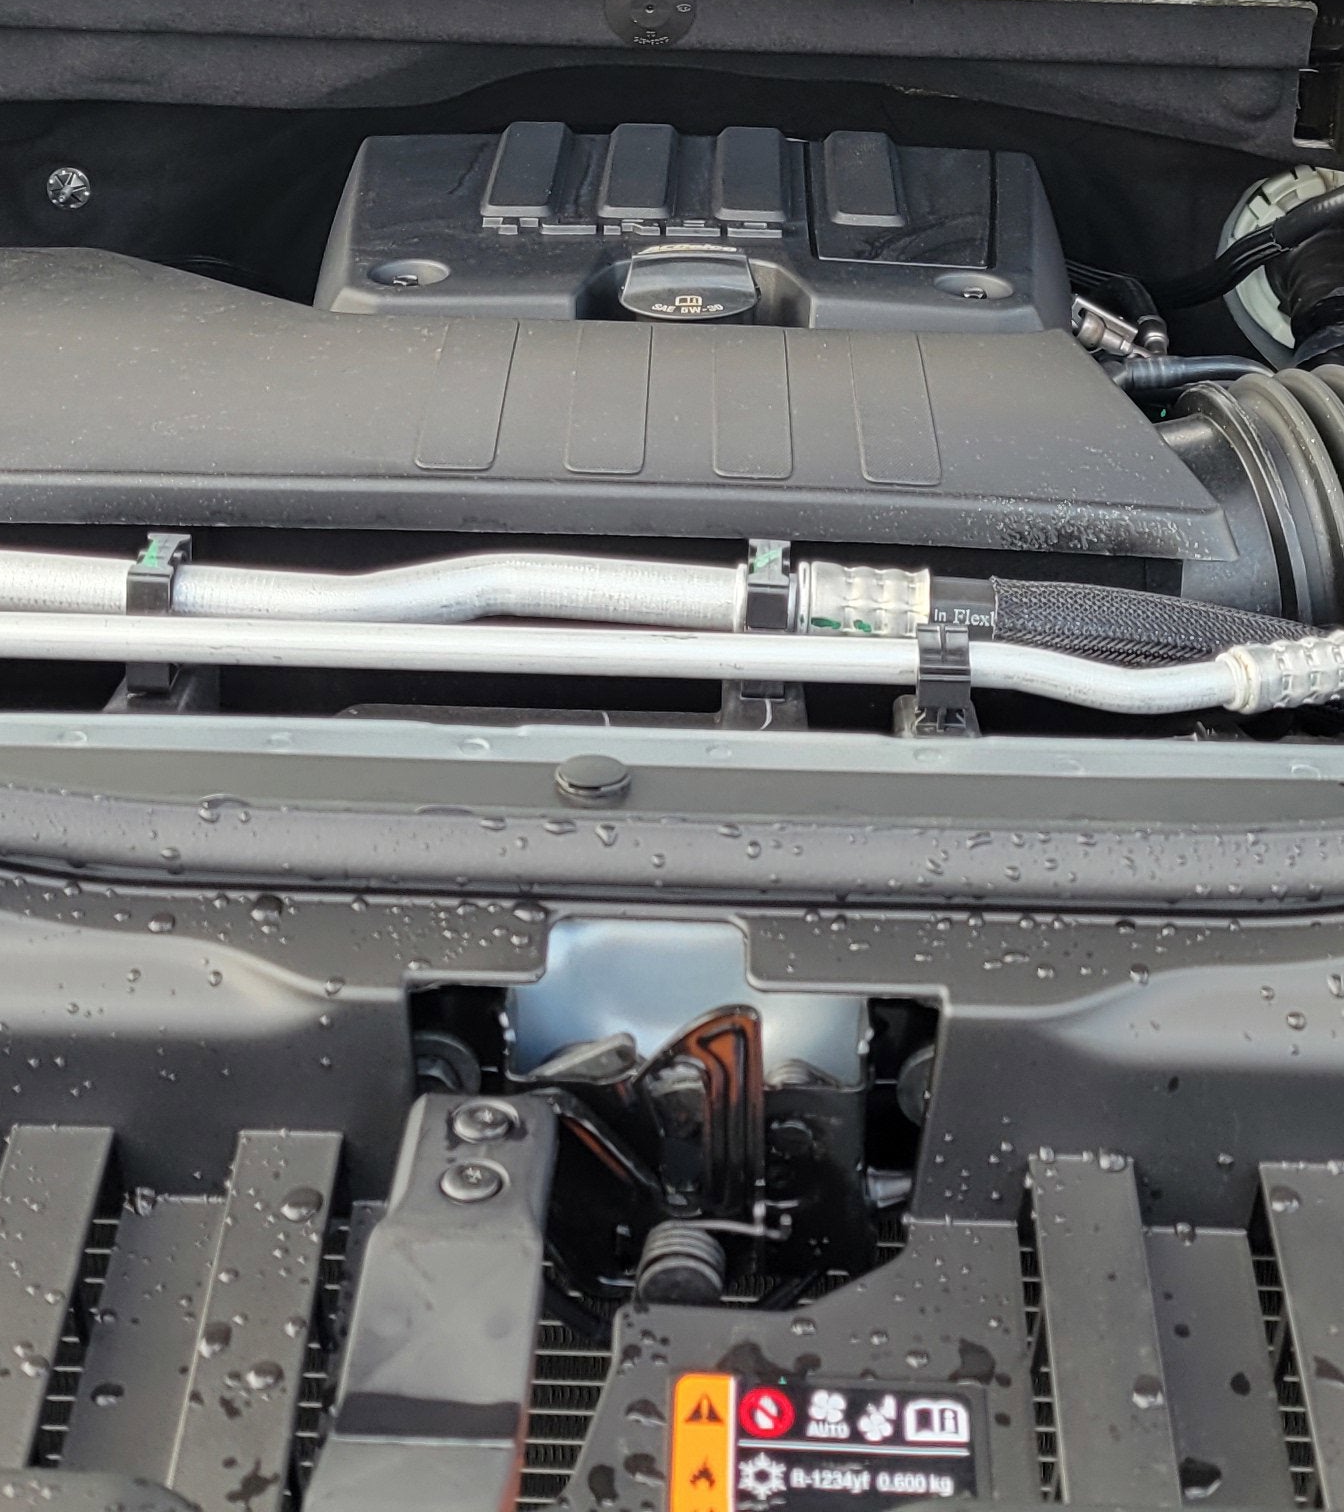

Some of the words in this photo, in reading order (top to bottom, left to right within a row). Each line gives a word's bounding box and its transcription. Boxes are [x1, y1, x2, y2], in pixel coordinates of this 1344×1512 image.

[652, 303, 676, 313] SAE
[806, 1420, 850, 1438] AUTO
[789, 1467, 871, 1494] R-1234yf
[876, 1471, 927, 1493] 0.600
[929, 1472, 954, 1497] kg
